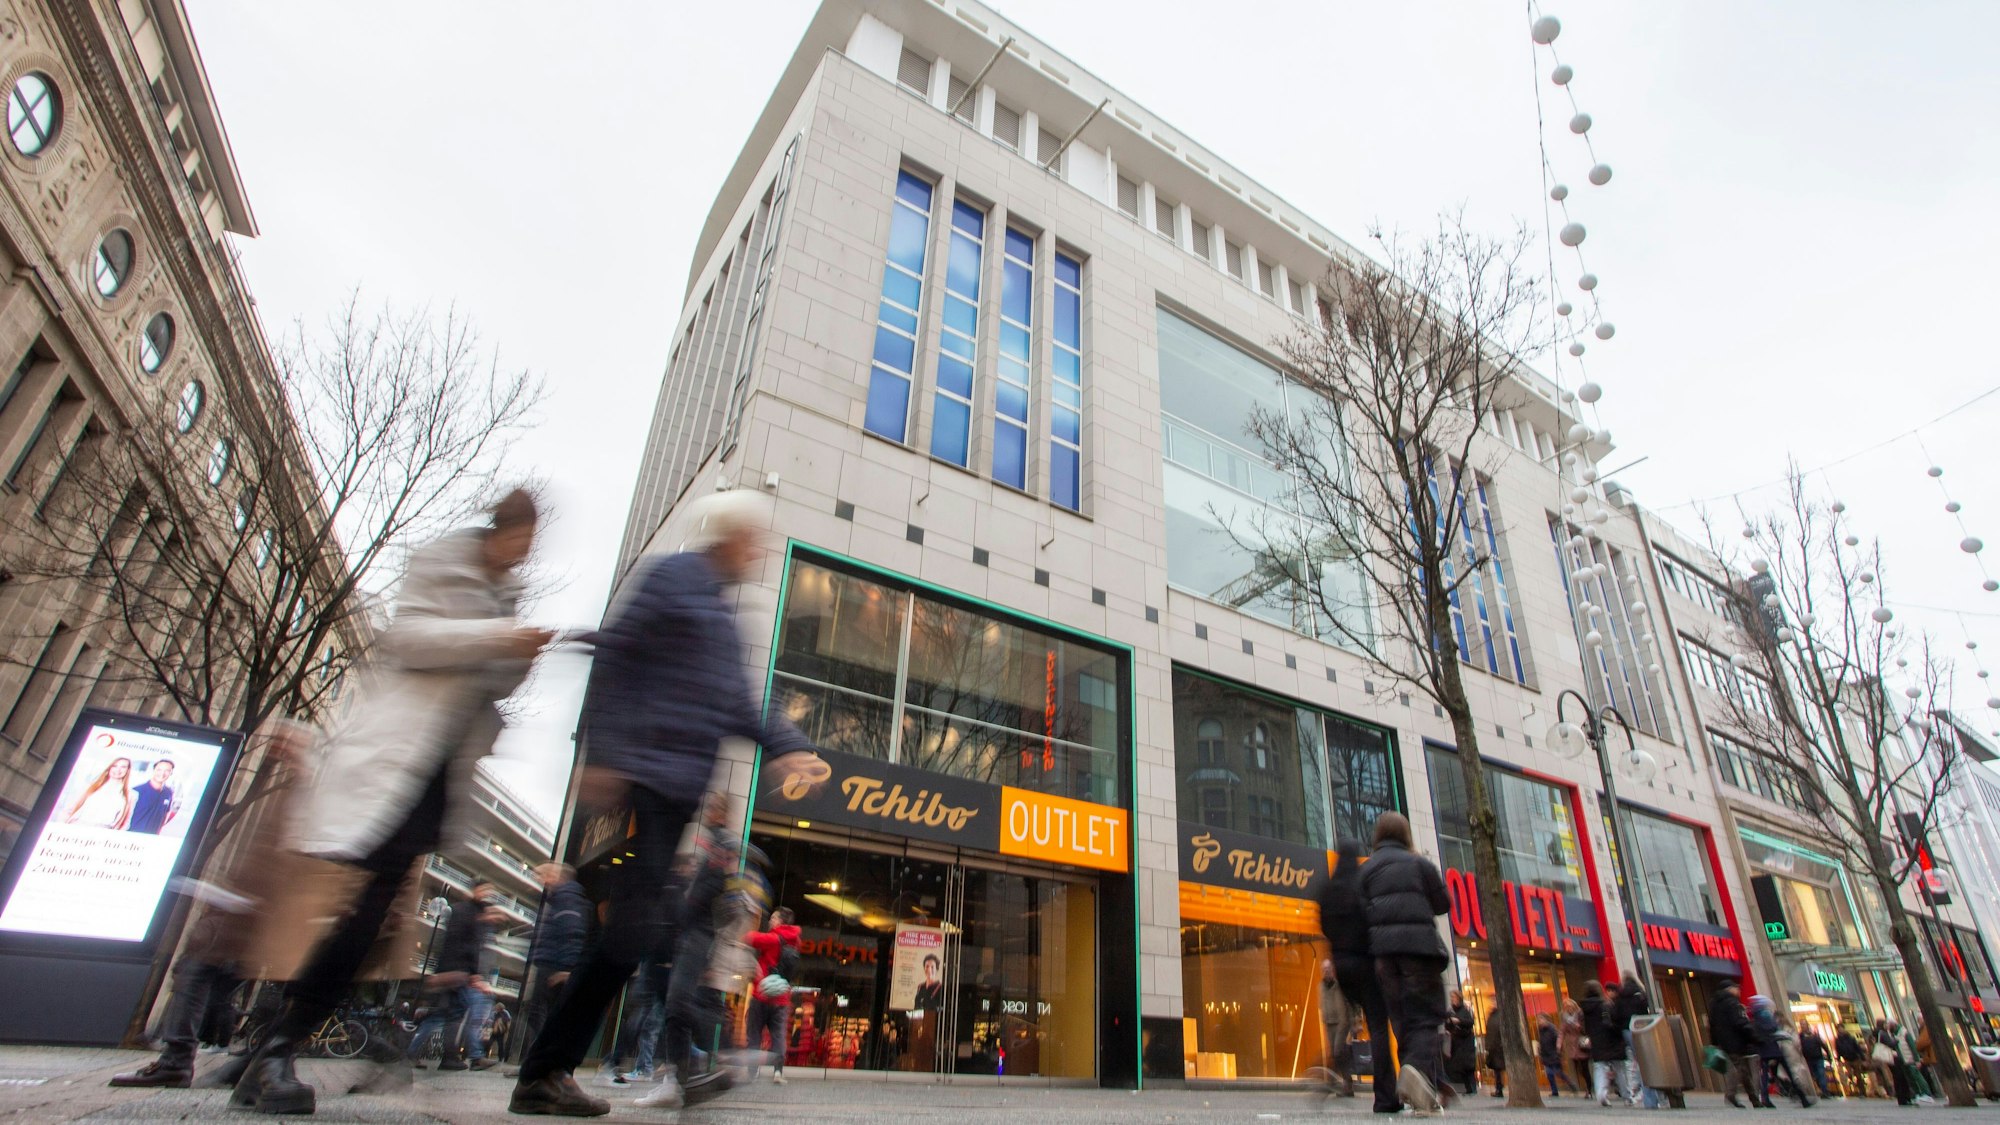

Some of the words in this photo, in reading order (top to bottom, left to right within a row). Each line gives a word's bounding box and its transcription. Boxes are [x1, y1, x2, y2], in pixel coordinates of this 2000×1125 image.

[841, 775, 979, 833] Tchibo
[1009, 800, 1120, 857] OUTLET
[40, 847, 90, 862] Region
[1227, 848, 1315, 890] Tchibo
[1446, 867, 1573, 954] OULET!
[1815, 970, 1848, 992] DOUGLAS
